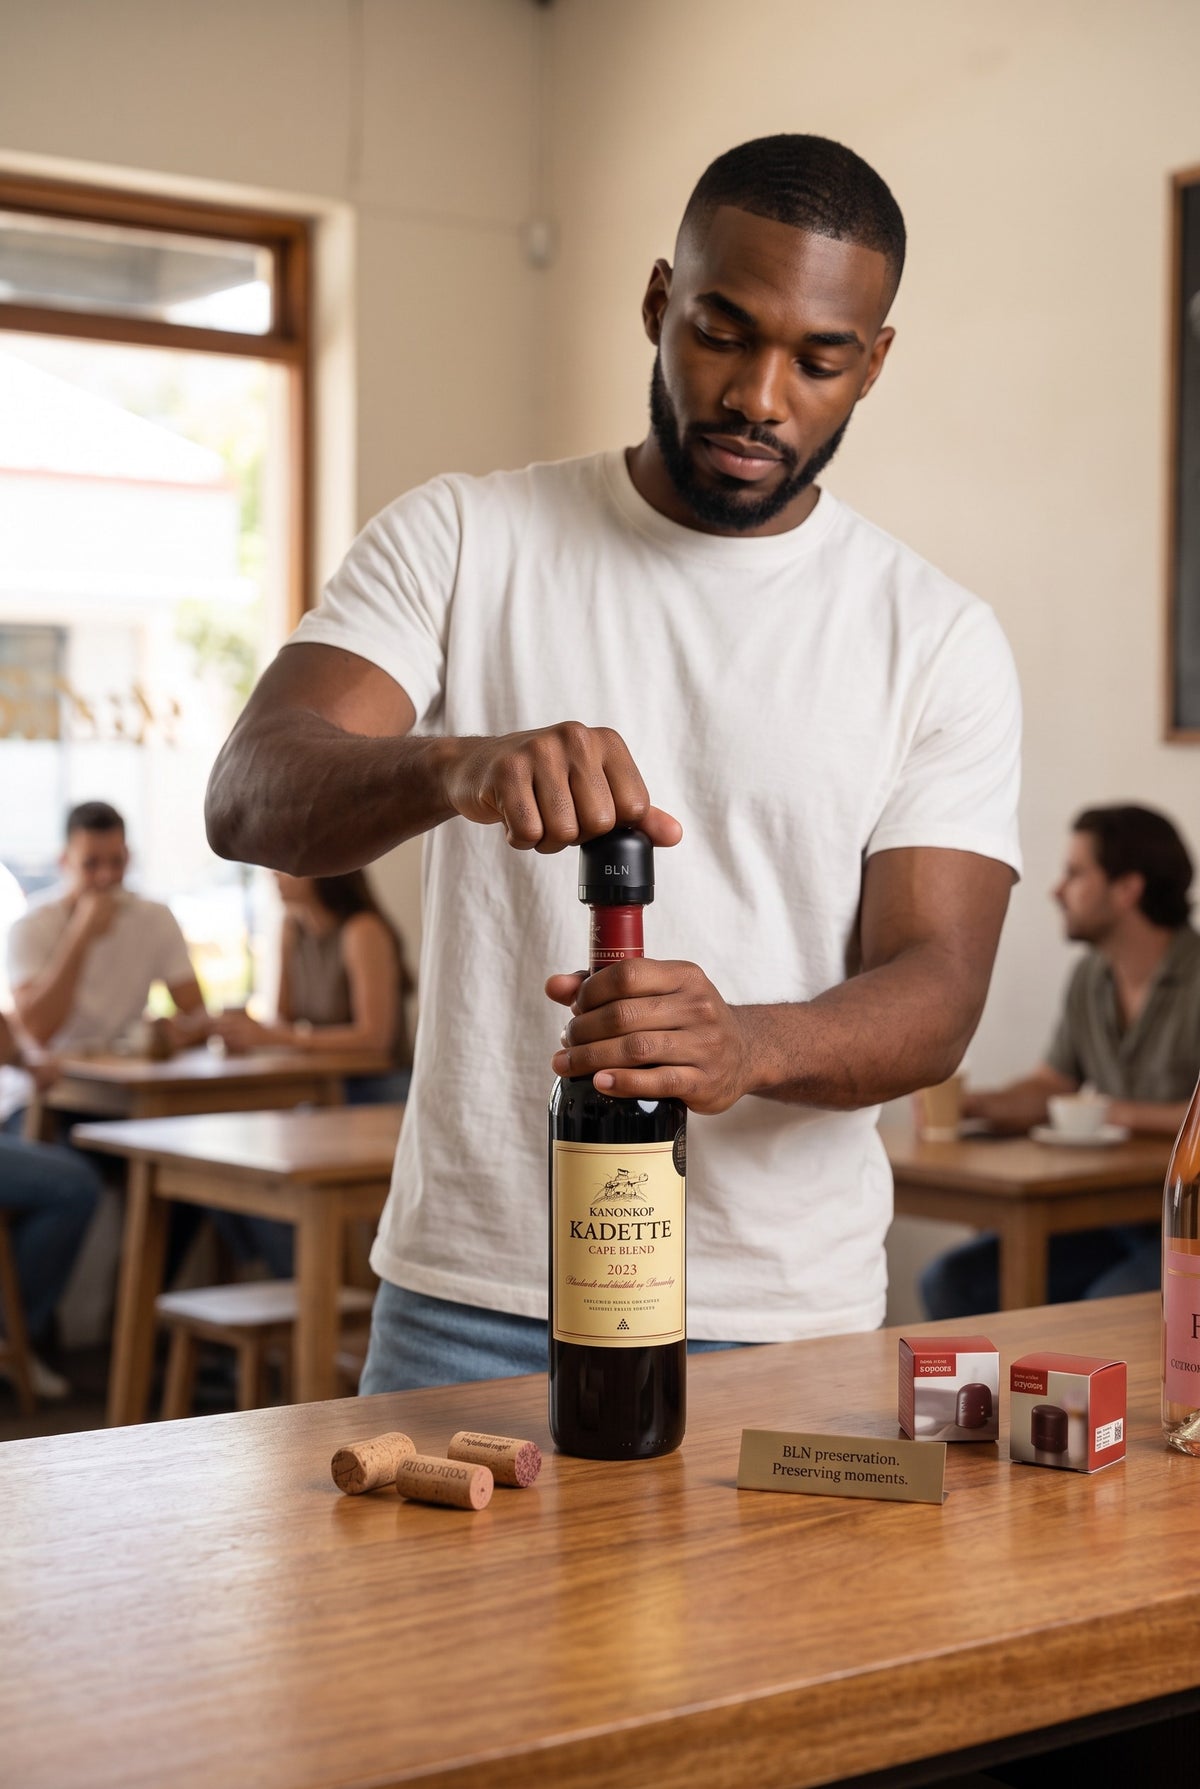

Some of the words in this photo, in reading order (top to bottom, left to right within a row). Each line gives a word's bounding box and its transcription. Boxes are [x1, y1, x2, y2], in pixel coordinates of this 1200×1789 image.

[604, 865, 630, 875] BLN
[589, 1206, 655, 1217] KANONKOP
[570, 1220, 672, 1241] KADETTE
[588, 1246, 617, 1255] CAPE
[619, 1245, 655, 1255] BLEND
[607, 1264, 637, 1276] 2023
[782, 1445, 812, 1459] BLN
[815, 1449, 900, 1466] preservation.
[772, 1463, 841, 1483] Preserving
[844, 1471, 908, 1485] moments.
